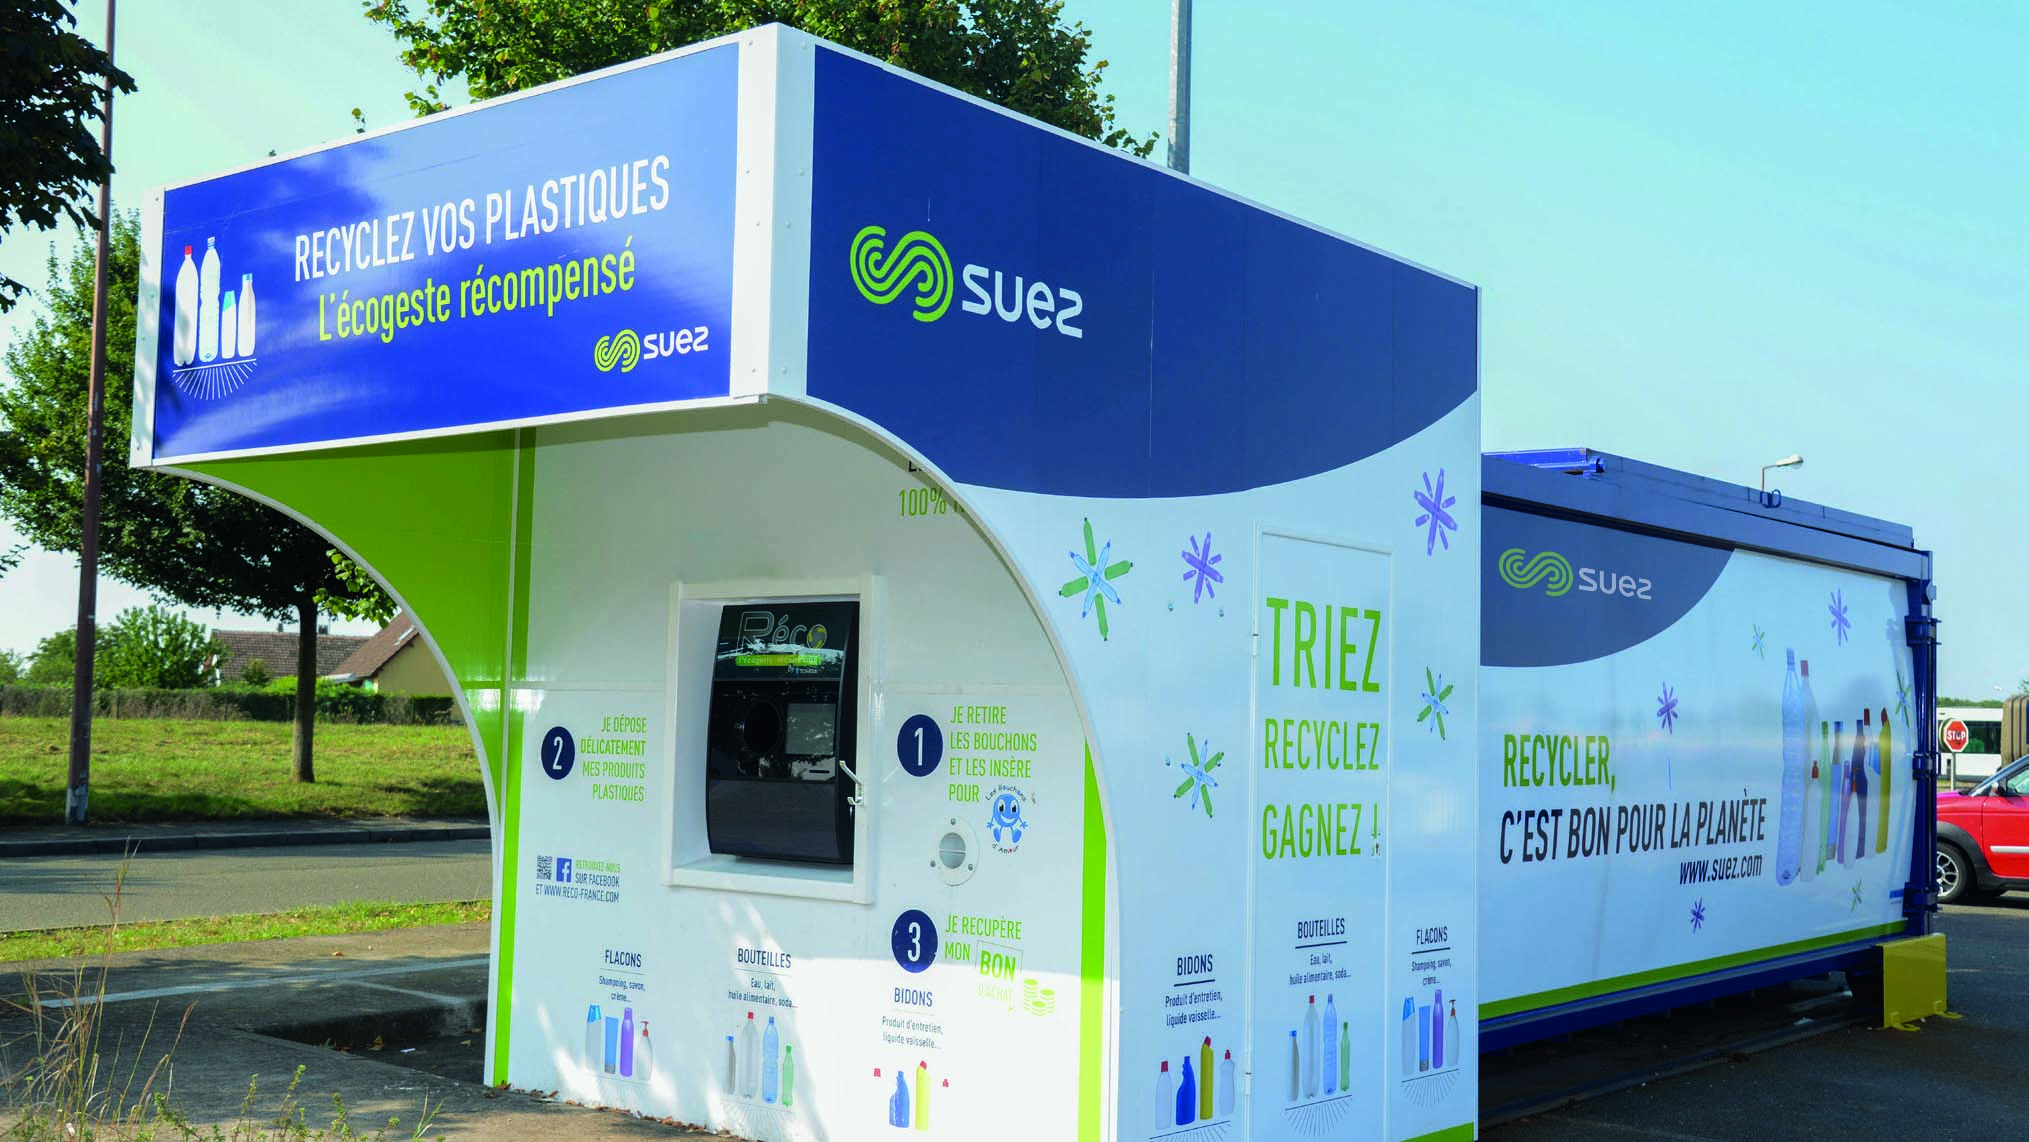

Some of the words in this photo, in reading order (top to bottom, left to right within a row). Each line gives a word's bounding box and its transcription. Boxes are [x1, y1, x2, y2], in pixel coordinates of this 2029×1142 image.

[295, 211, 415, 282] RECYCLEZ
[422, 198, 476, 256] VOS
[485, 155, 670, 245] PLASTIQUES
[319, 277, 450, 343] L'écogeste
[460, 235, 636, 317] récompensé
[962, 264, 1083, 339] suez
[643, 326, 710, 361] suez
[899, 488, 947, 517] 100%
[1578, 567, 1652, 600] suez
[1266, 597, 1381, 692] TRIEZ
[601, 715, 611, 733] JE
[613, 713, 647, 734] DÉPOSE
[950, 706, 963, 724] JE
[967, 706, 1007, 725] RETIRE
[580, 736, 647, 756] DÉLICATEMENT
[950, 731, 970, 750] LES
[973, 732, 1037, 752] BOUCHONS
[1264, 718, 1380, 770] RECYCLEZ
[1946, 730, 1966, 741] STOP
[552, 736, 563, 770] 2
[914, 727, 924, 767] 1
[583, 761, 600, 777] MES
[603, 761, 645, 779] PRODUITS
[949, 757, 962, 776] ET
[966, 758, 986, 777] LES
[1503, 734, 1616, 792] RECYCLER,
[593, 783, 645, 802] PLASTIQUES
[949, 783, 979, 802] POUR
[1262, 803, 1362, 860] GAGNEZ
[1500, 808, 1562, 864] C'EST
[1567, 806, 1611, 859] BON
[1615, 803, 1666, 854] POUR
[1670, 801, 1690, 848] LA
[1695, 788, 1767, 847] PLANÈTE
[1679, 854, 1763, 885] www.suez.com
[575, 873, 587, 884] SUR
[589, 874, 620, 888] FACEBOOK
[536, 883, 543, 895] ET
[543, 884, 620, 903] WWW.RECO-FRANCE.COM
[945, 914, 959, 934] JE
[1297, 917, 1345, 939] BOUTEILLES
[907, 922, 921, 962] 3
[1416, 926, 1448, 945] FLACONS
[605, 949, 642, 968] FLACONS
[737, 948, 791, 969] BOUTEILLES
[944, 941, 971, 961] MON
[979, 950, 1016, 982] BON
[1177, 954, 1213, 976] BIDONS
[751, 978, 763, 990] Eau,
[764, 979, 776, 992] lait,
[894, 987, 933, 1007] BIDONS
[1165, 994, 1187, 1008] Produit
[882, 1015, 905, 1029] Produit
